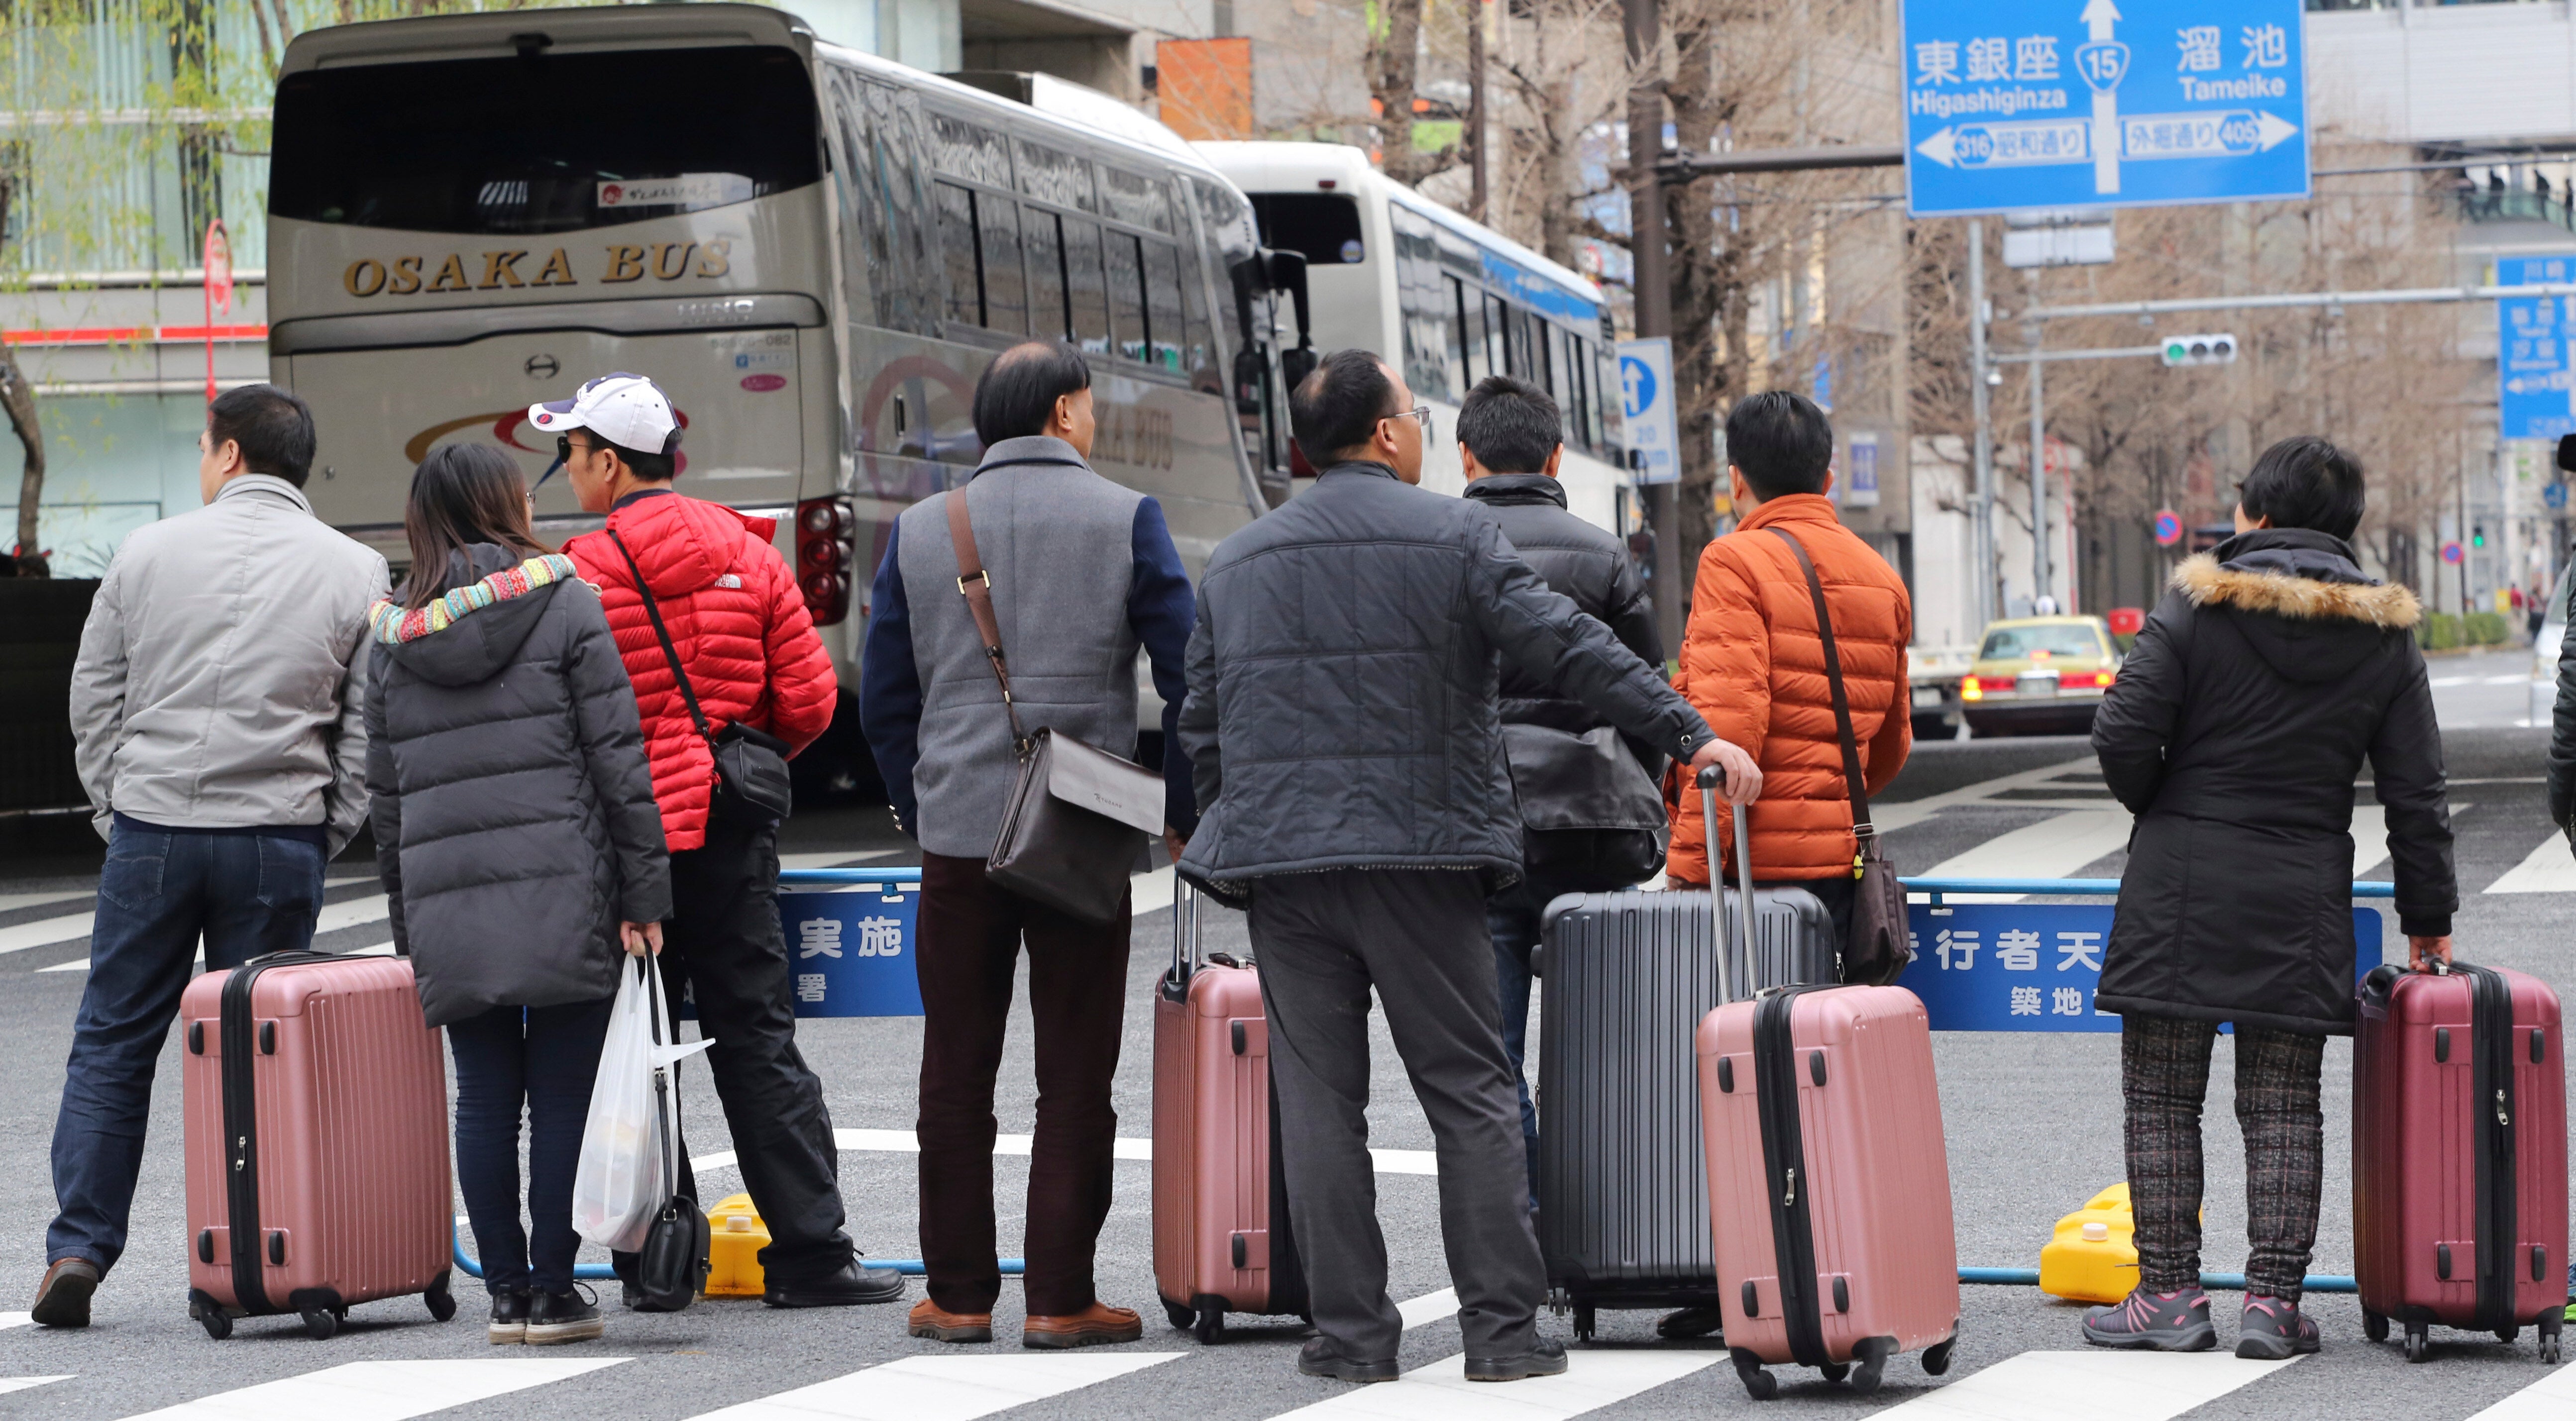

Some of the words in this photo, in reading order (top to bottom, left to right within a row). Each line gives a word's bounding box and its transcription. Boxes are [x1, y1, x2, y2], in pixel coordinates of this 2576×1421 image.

[1914, 34, 2060, 86] 東銀座
[2176, 22, 2288, 73] 溜池
[2087, 49, 2119, 80] 15
[1911, 85, 2067, 118] Higashiginza
[2177, 73, 2287, 102] Tameike
[1956, 133, 1991, 159] 316
[2221, 120, 2257, 145] 405
[343, 248, 577, 298] OSAKA
[601, 240, 733, 284] BUS
[799, 915, 902, 959] 実施
[797, 973, 827, 1002] 署
[2010, 986, 2121, 1017] 築地
